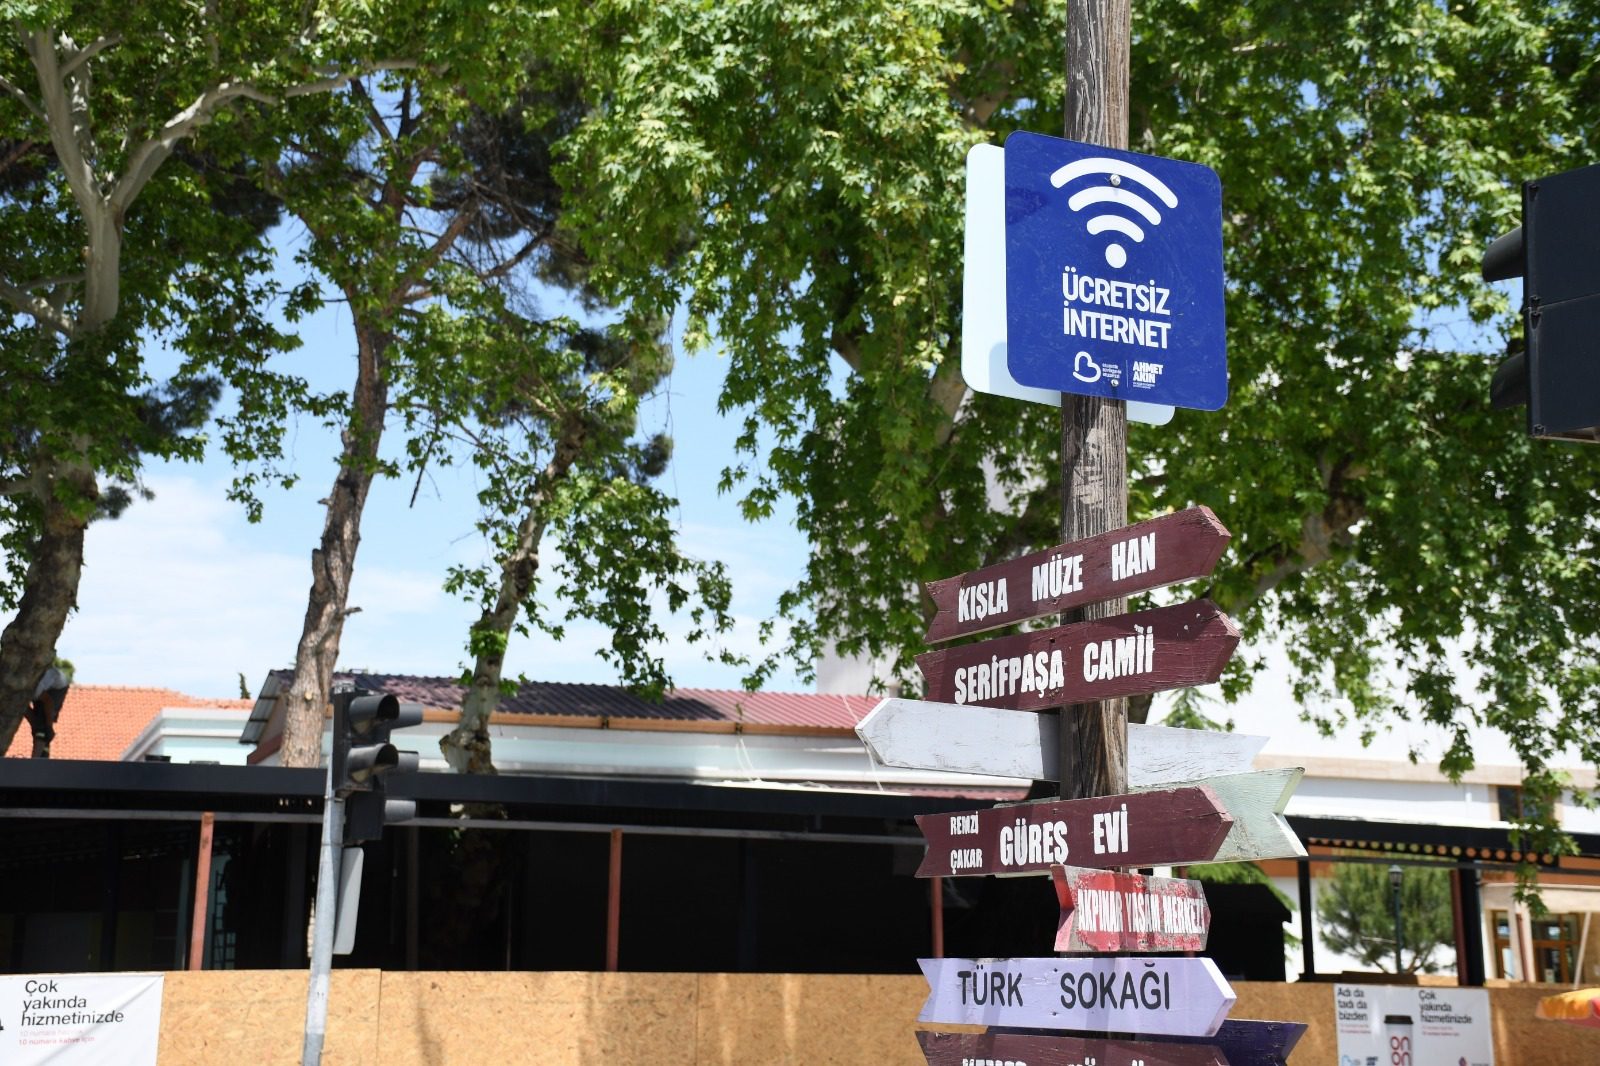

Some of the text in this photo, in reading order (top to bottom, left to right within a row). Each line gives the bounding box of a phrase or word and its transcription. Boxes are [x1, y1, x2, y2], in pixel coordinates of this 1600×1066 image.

[1062, 266, 1171, 316] ÜCRETSİZ
[1063, 300, 1172, 349] İNTERNET
[1133, 361, 1164, 375] AHMET
[1133, 372, 1156, 384] AKIN
[958, 533, 1156, 622] KIŞLA MÜZE HAN
[950, 811, 979, 836] REMZİ
[1093, 804, 1129, 854] EVİ
[950, 848, 983, 875] ÇAKAR
[1076, 888, 1124, 933] AKPINAR
[25, 980, 58, 997] Çok
[957, 962, 1170, 1010] TÜRK SOKAĞI
[1419, 990, 1436, 1001] Çok
[23, 996, 87, 1012] yakında
[1419, 1002, 1452, 1014] yakında
[21, 1010, 124, 1027] hizmetinizde
[1421, 1014, 1473, 1024] hizmetinizde
